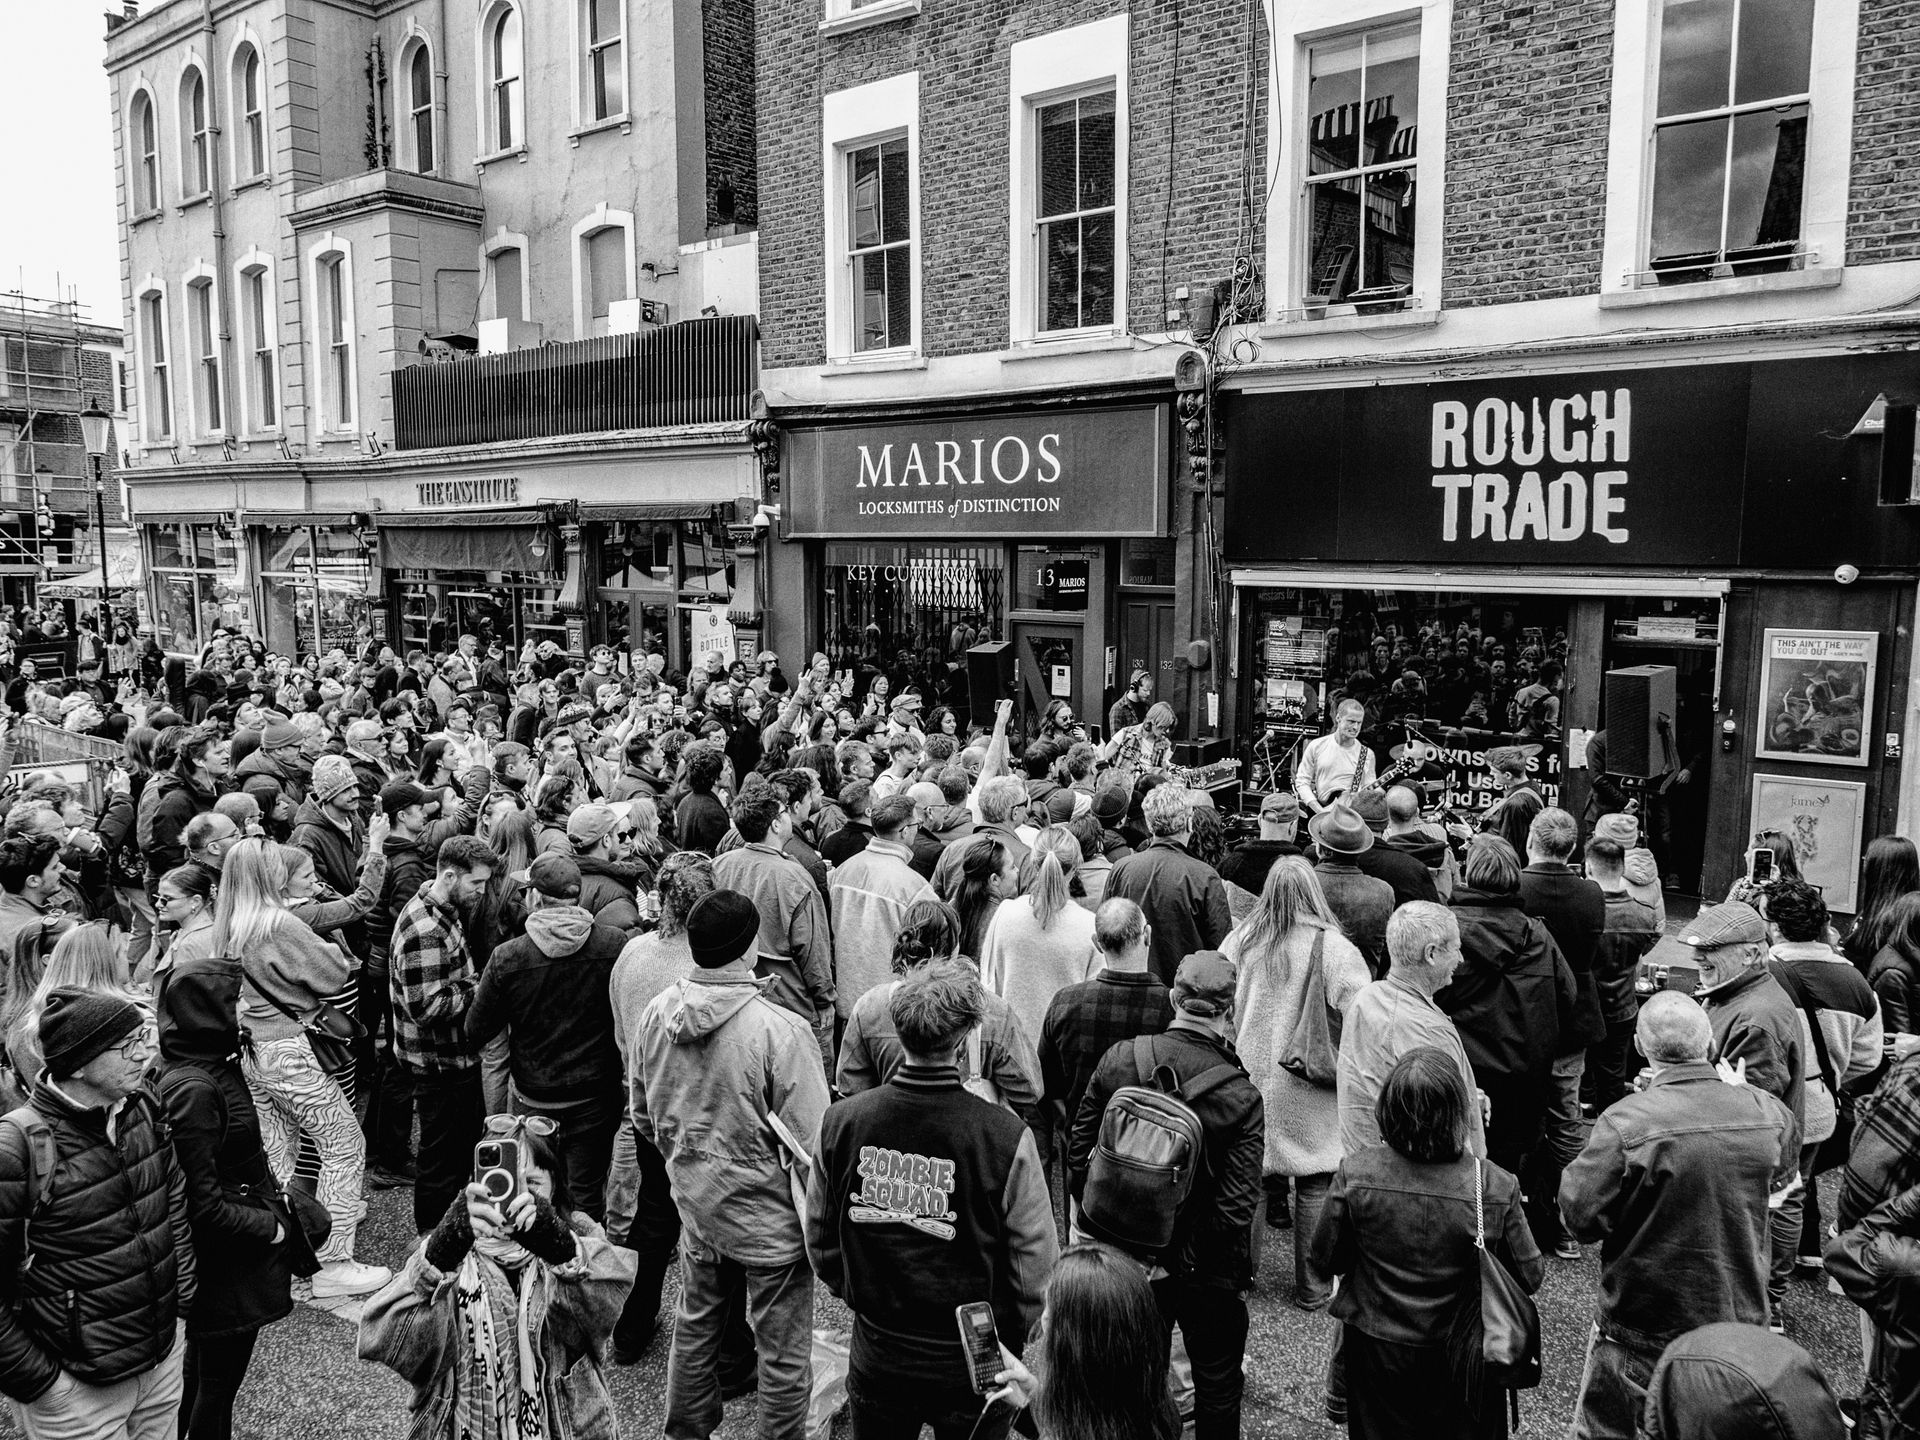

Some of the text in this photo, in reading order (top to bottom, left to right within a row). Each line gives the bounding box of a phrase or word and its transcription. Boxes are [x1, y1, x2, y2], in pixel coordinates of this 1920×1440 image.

[1432, 388, 1631, 468] ROUGH
[856, 434, 1061, 487] MARIOS
[416, 482, 444, 505] THE
[859, 497, 1061, 518] LOCKSMITHS of DISTINCTION
[1432, 470, 1629, 543] TRADE
[847, 564, 968, 583] KEY CUTTNG
[1059, 577, 1086, 588] MARIOS
[700, 636, 729, 652] BOTTLE
[1777, 647, 1794, 655] YOU
[1811, 648, 1828, 656] OUT
[1778, 640, 1864, 650] THIS AIN'T THE WAY
[1160, 661, 1173, 670] 132
[1791, 794, 1825, 808] james
[857, 1146, 955, 1193] ZOMBIE
[862, 1177, 948, 1217] SQUAD
